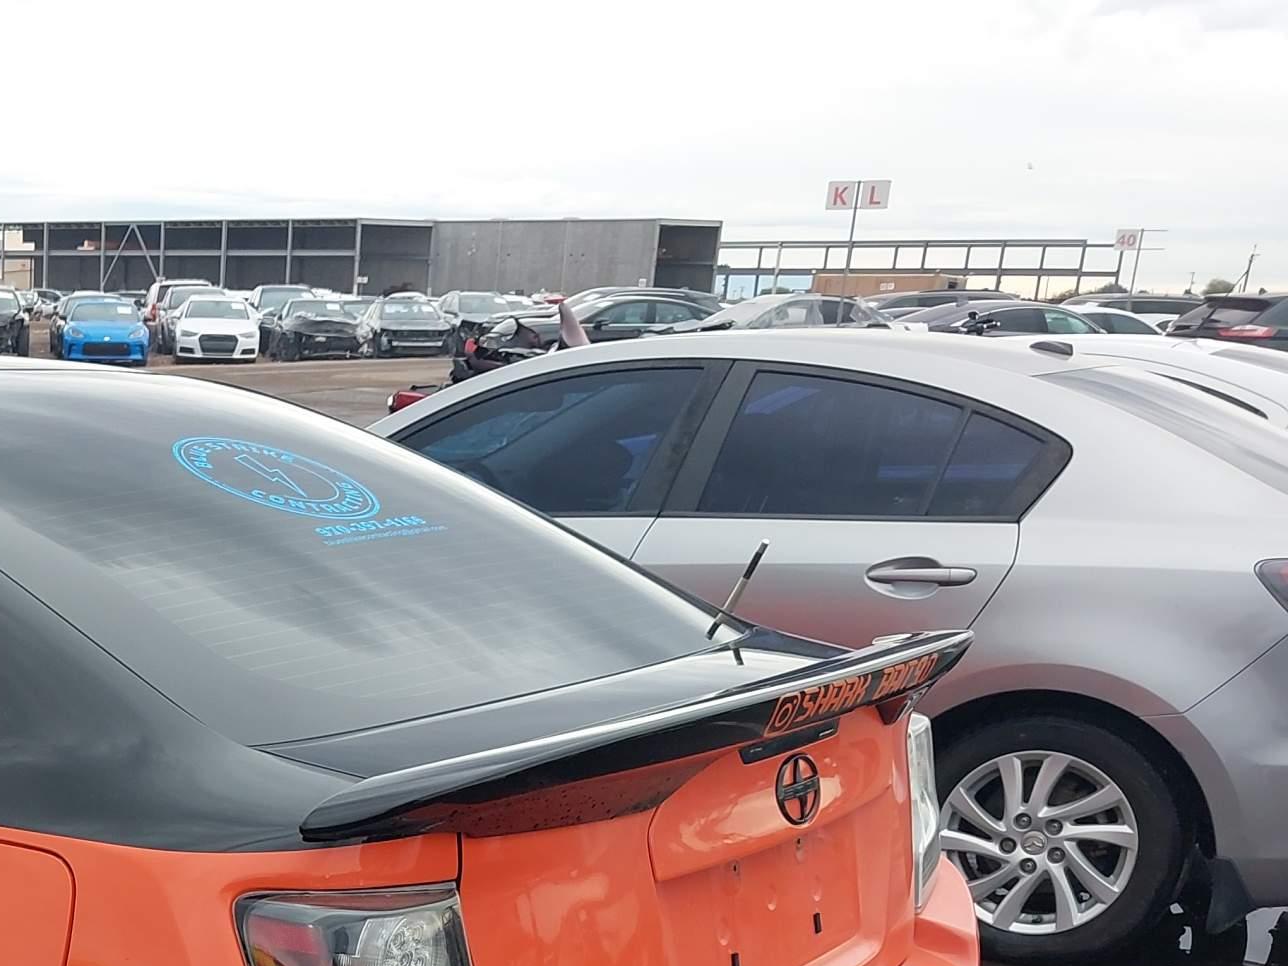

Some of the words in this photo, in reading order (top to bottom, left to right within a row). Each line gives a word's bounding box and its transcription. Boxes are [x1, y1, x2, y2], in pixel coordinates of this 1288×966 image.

[832, 186, 849, 206] K
[869, 185, 881, 205] L
[1116, 234, 1137, 247] 40
[189, 445, 213, 469] BLUE
[251, 481, 364, 512] CONTRACTING
[795, 673, 872, 722] SHARK
